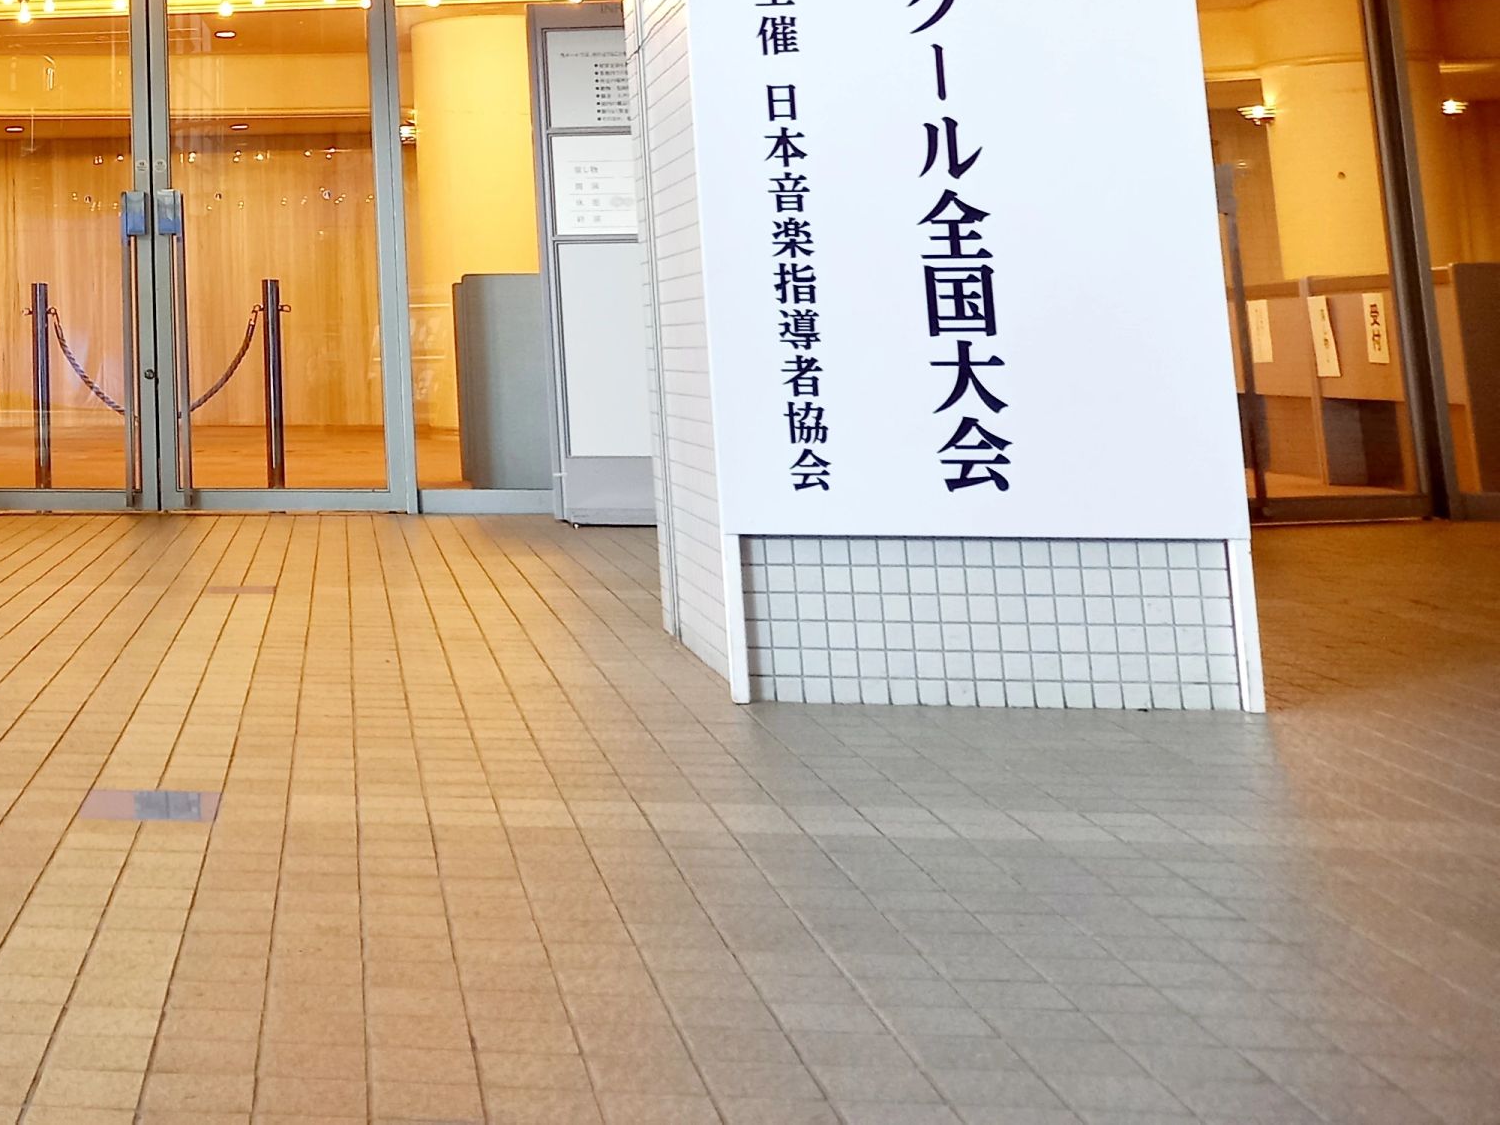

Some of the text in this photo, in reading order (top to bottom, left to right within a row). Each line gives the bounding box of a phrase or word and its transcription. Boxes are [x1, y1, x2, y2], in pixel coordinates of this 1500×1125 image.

[765, 84, 831, 491] 日本音楽指導者協会
